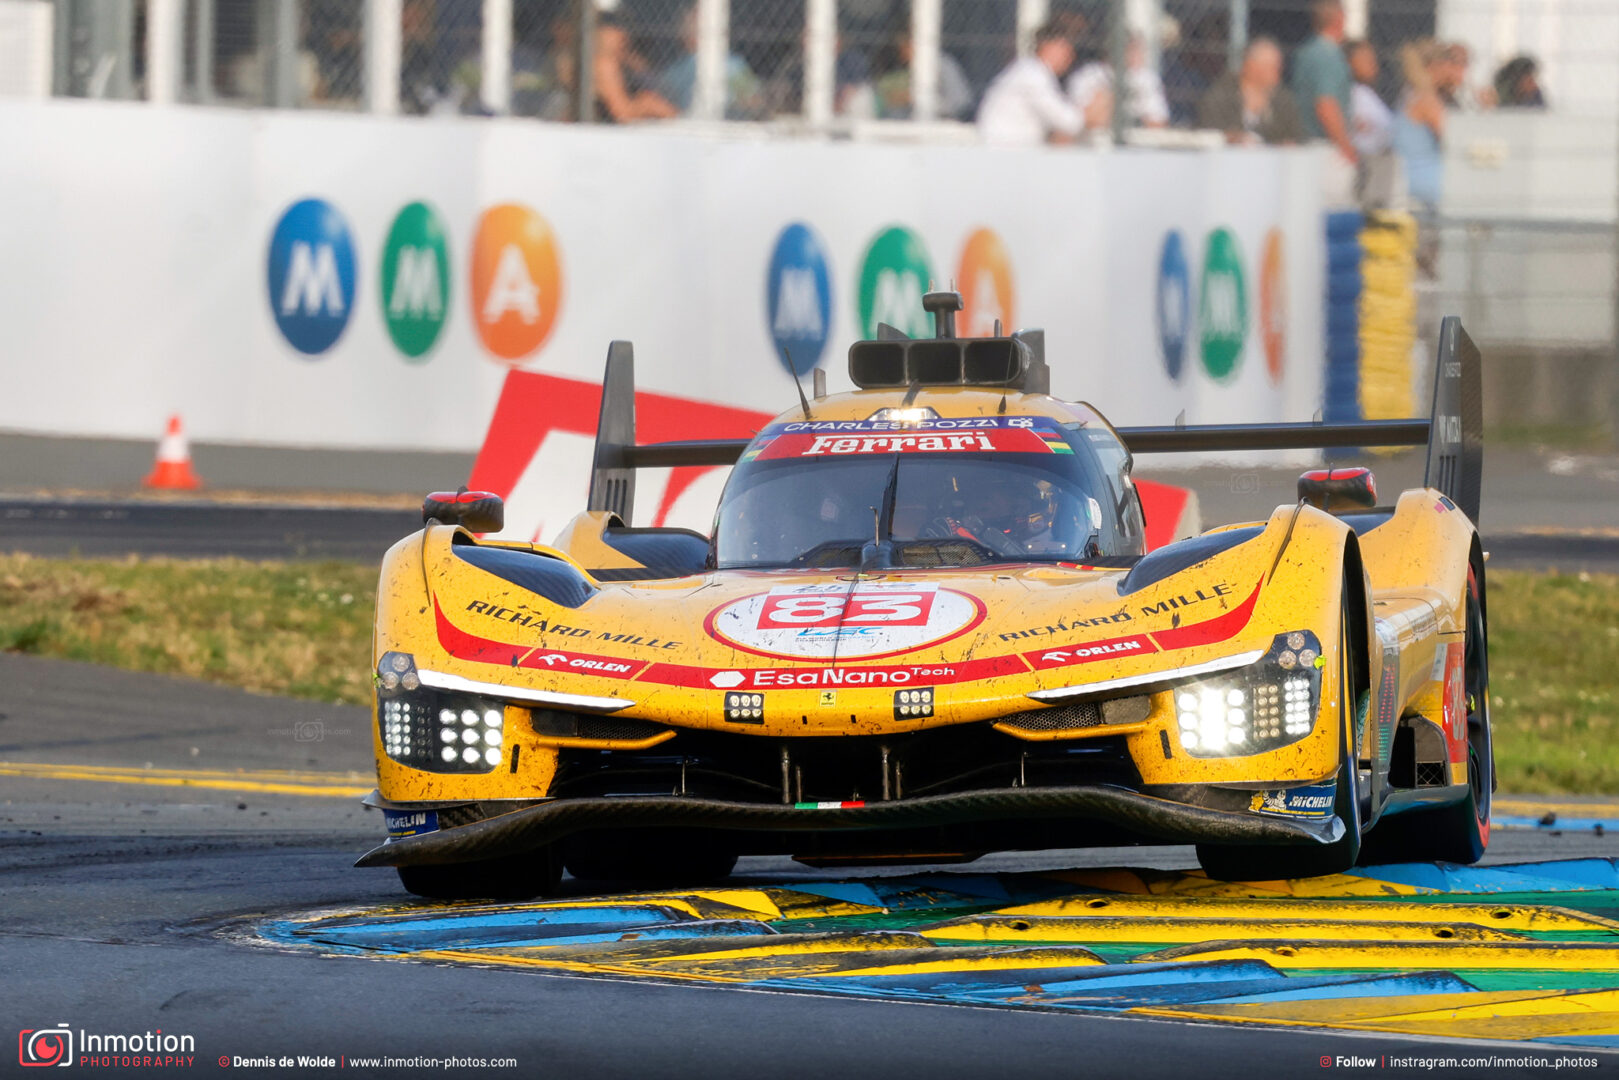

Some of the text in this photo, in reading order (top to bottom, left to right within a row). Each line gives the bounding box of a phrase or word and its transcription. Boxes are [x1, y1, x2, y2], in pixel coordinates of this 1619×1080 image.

[784, 419, 998, 431] CHARLES POZZI
[802, 432, 996, 455] Ferrari
[768, 594, 923, 623] 83
[999, 582, 1233, 642] RICHARD MILLE
[466, 599, 683, 650] RICHARD MILLE
[1075, 640, 1142, 657] ORLEN
[569, 657, 632, 673] ORLEN
